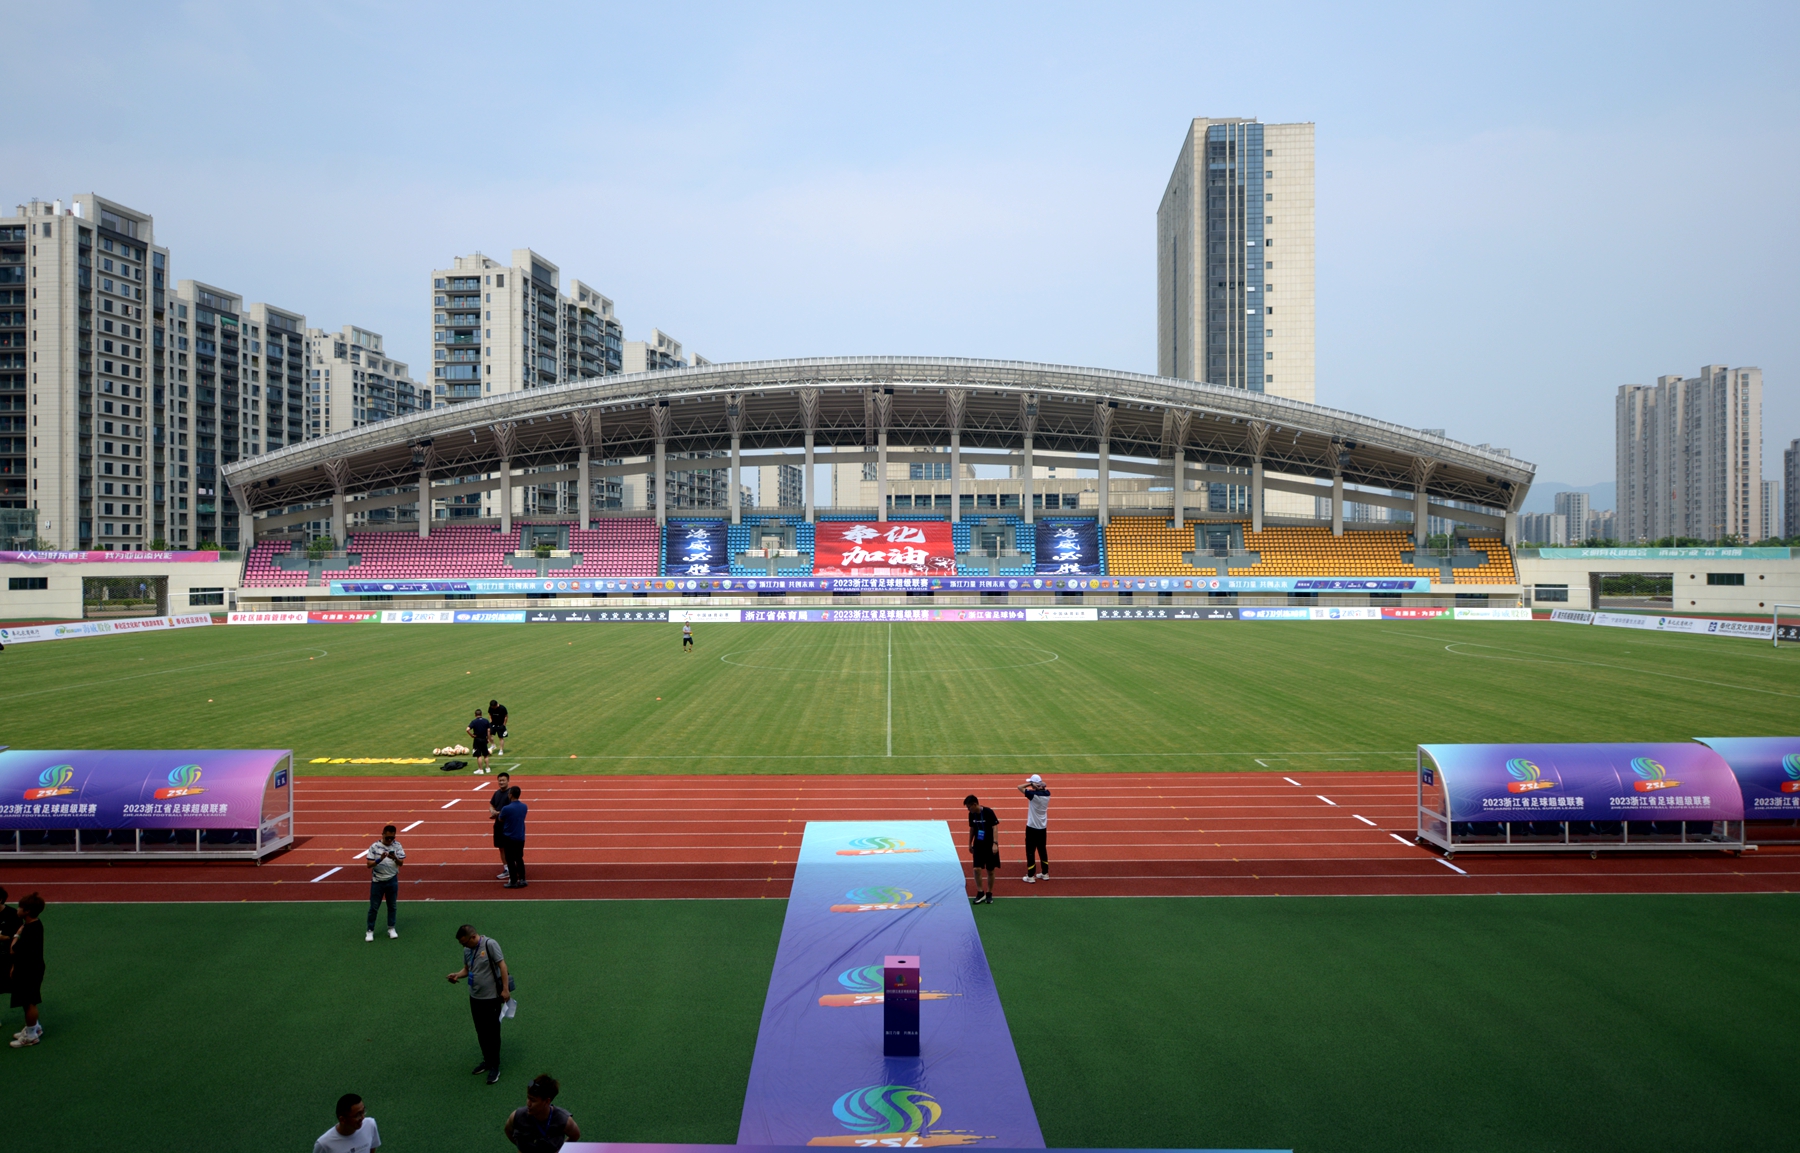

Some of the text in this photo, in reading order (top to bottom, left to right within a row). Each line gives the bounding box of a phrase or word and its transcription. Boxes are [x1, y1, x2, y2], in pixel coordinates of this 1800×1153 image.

[840, 525, 926, 544] 奉化
[683, 529, 713, 575] 海威必胜
[841, 546, 929, 566] 加油
[1052, 528, 1083, 574] 海威必胜
[833, 579, 928, 588] 2023浙江省足球超级联赛
[745, 611, 808, 620] 浙江省体育局
[834, 610, 929, 620] 2023浙江省足球超级联赛
[968, 610, 1024, 618] 浙江省足球协会
[36, 789, 59, 797] ZSL
[167, 789, 189, 797] ZSL
[1482, 797, 1584, 807] 2023浙江省足球超级联赛
[1609, 796, 1711, 806] 2023浙江省足球超级联赛
[122, 804, 228, 814] 2023浙江省足球超级联赛
[854, 1136, 924, 1148] ZSL
